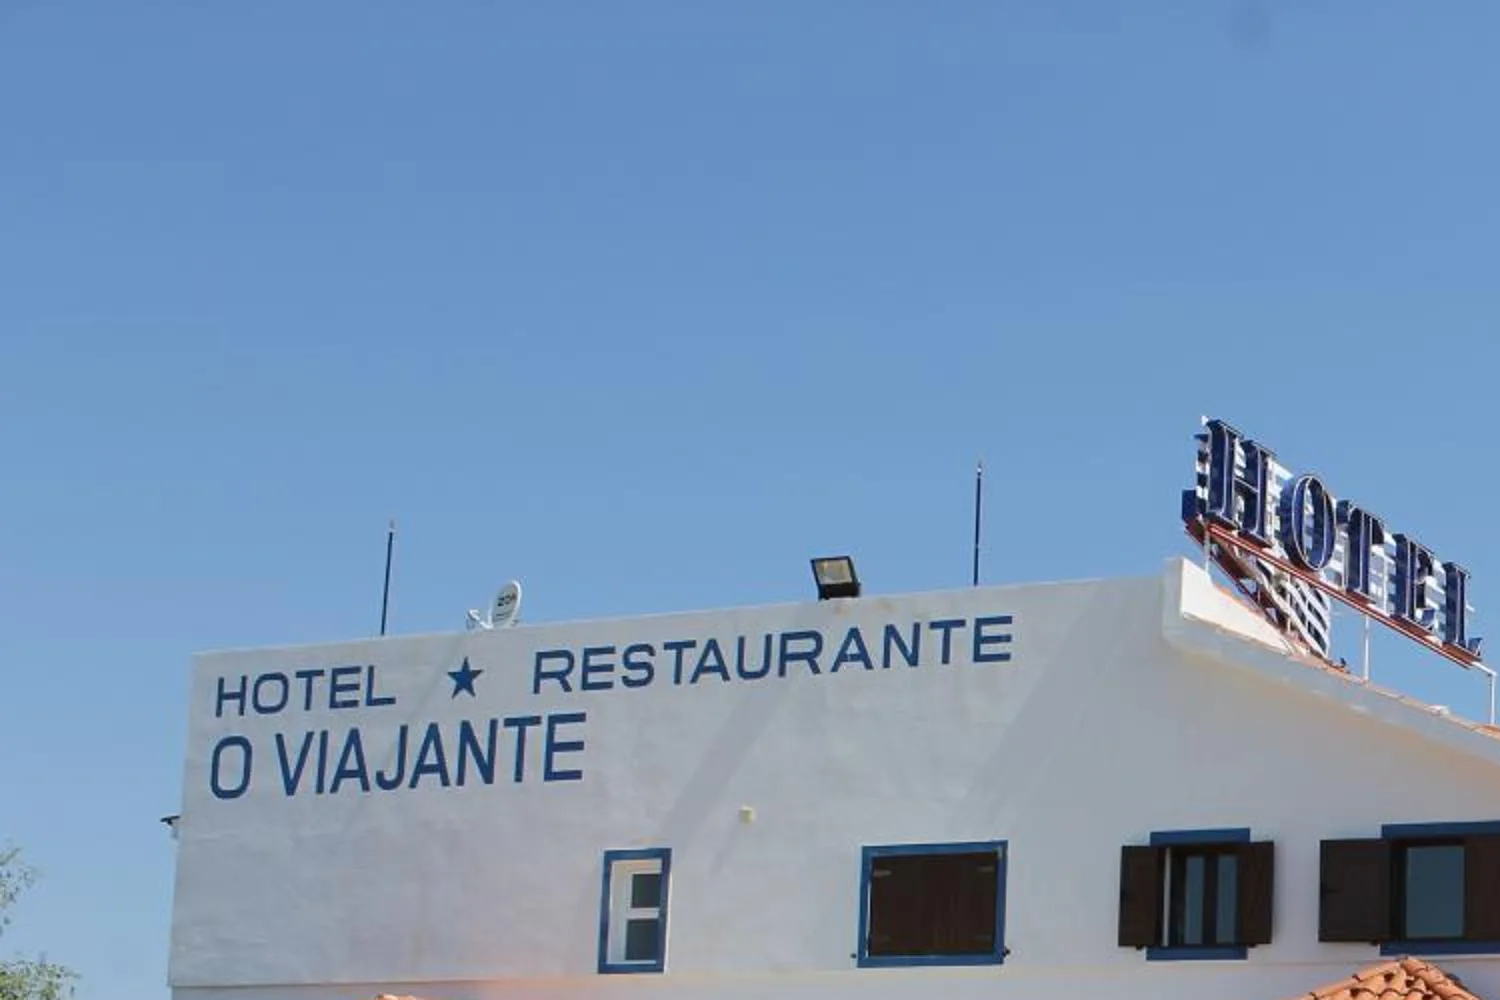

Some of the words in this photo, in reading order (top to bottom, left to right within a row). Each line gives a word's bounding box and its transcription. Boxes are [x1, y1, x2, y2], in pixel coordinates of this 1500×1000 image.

[1196, 418, 1482, 662] HOTEL
[215, 664, 397, 718] HOTEL
[532, 615, 1013, 695] RESTAURANTE
[210, 735, 253, 800] O
[275, 711, 587, 796] VIAJANTE
